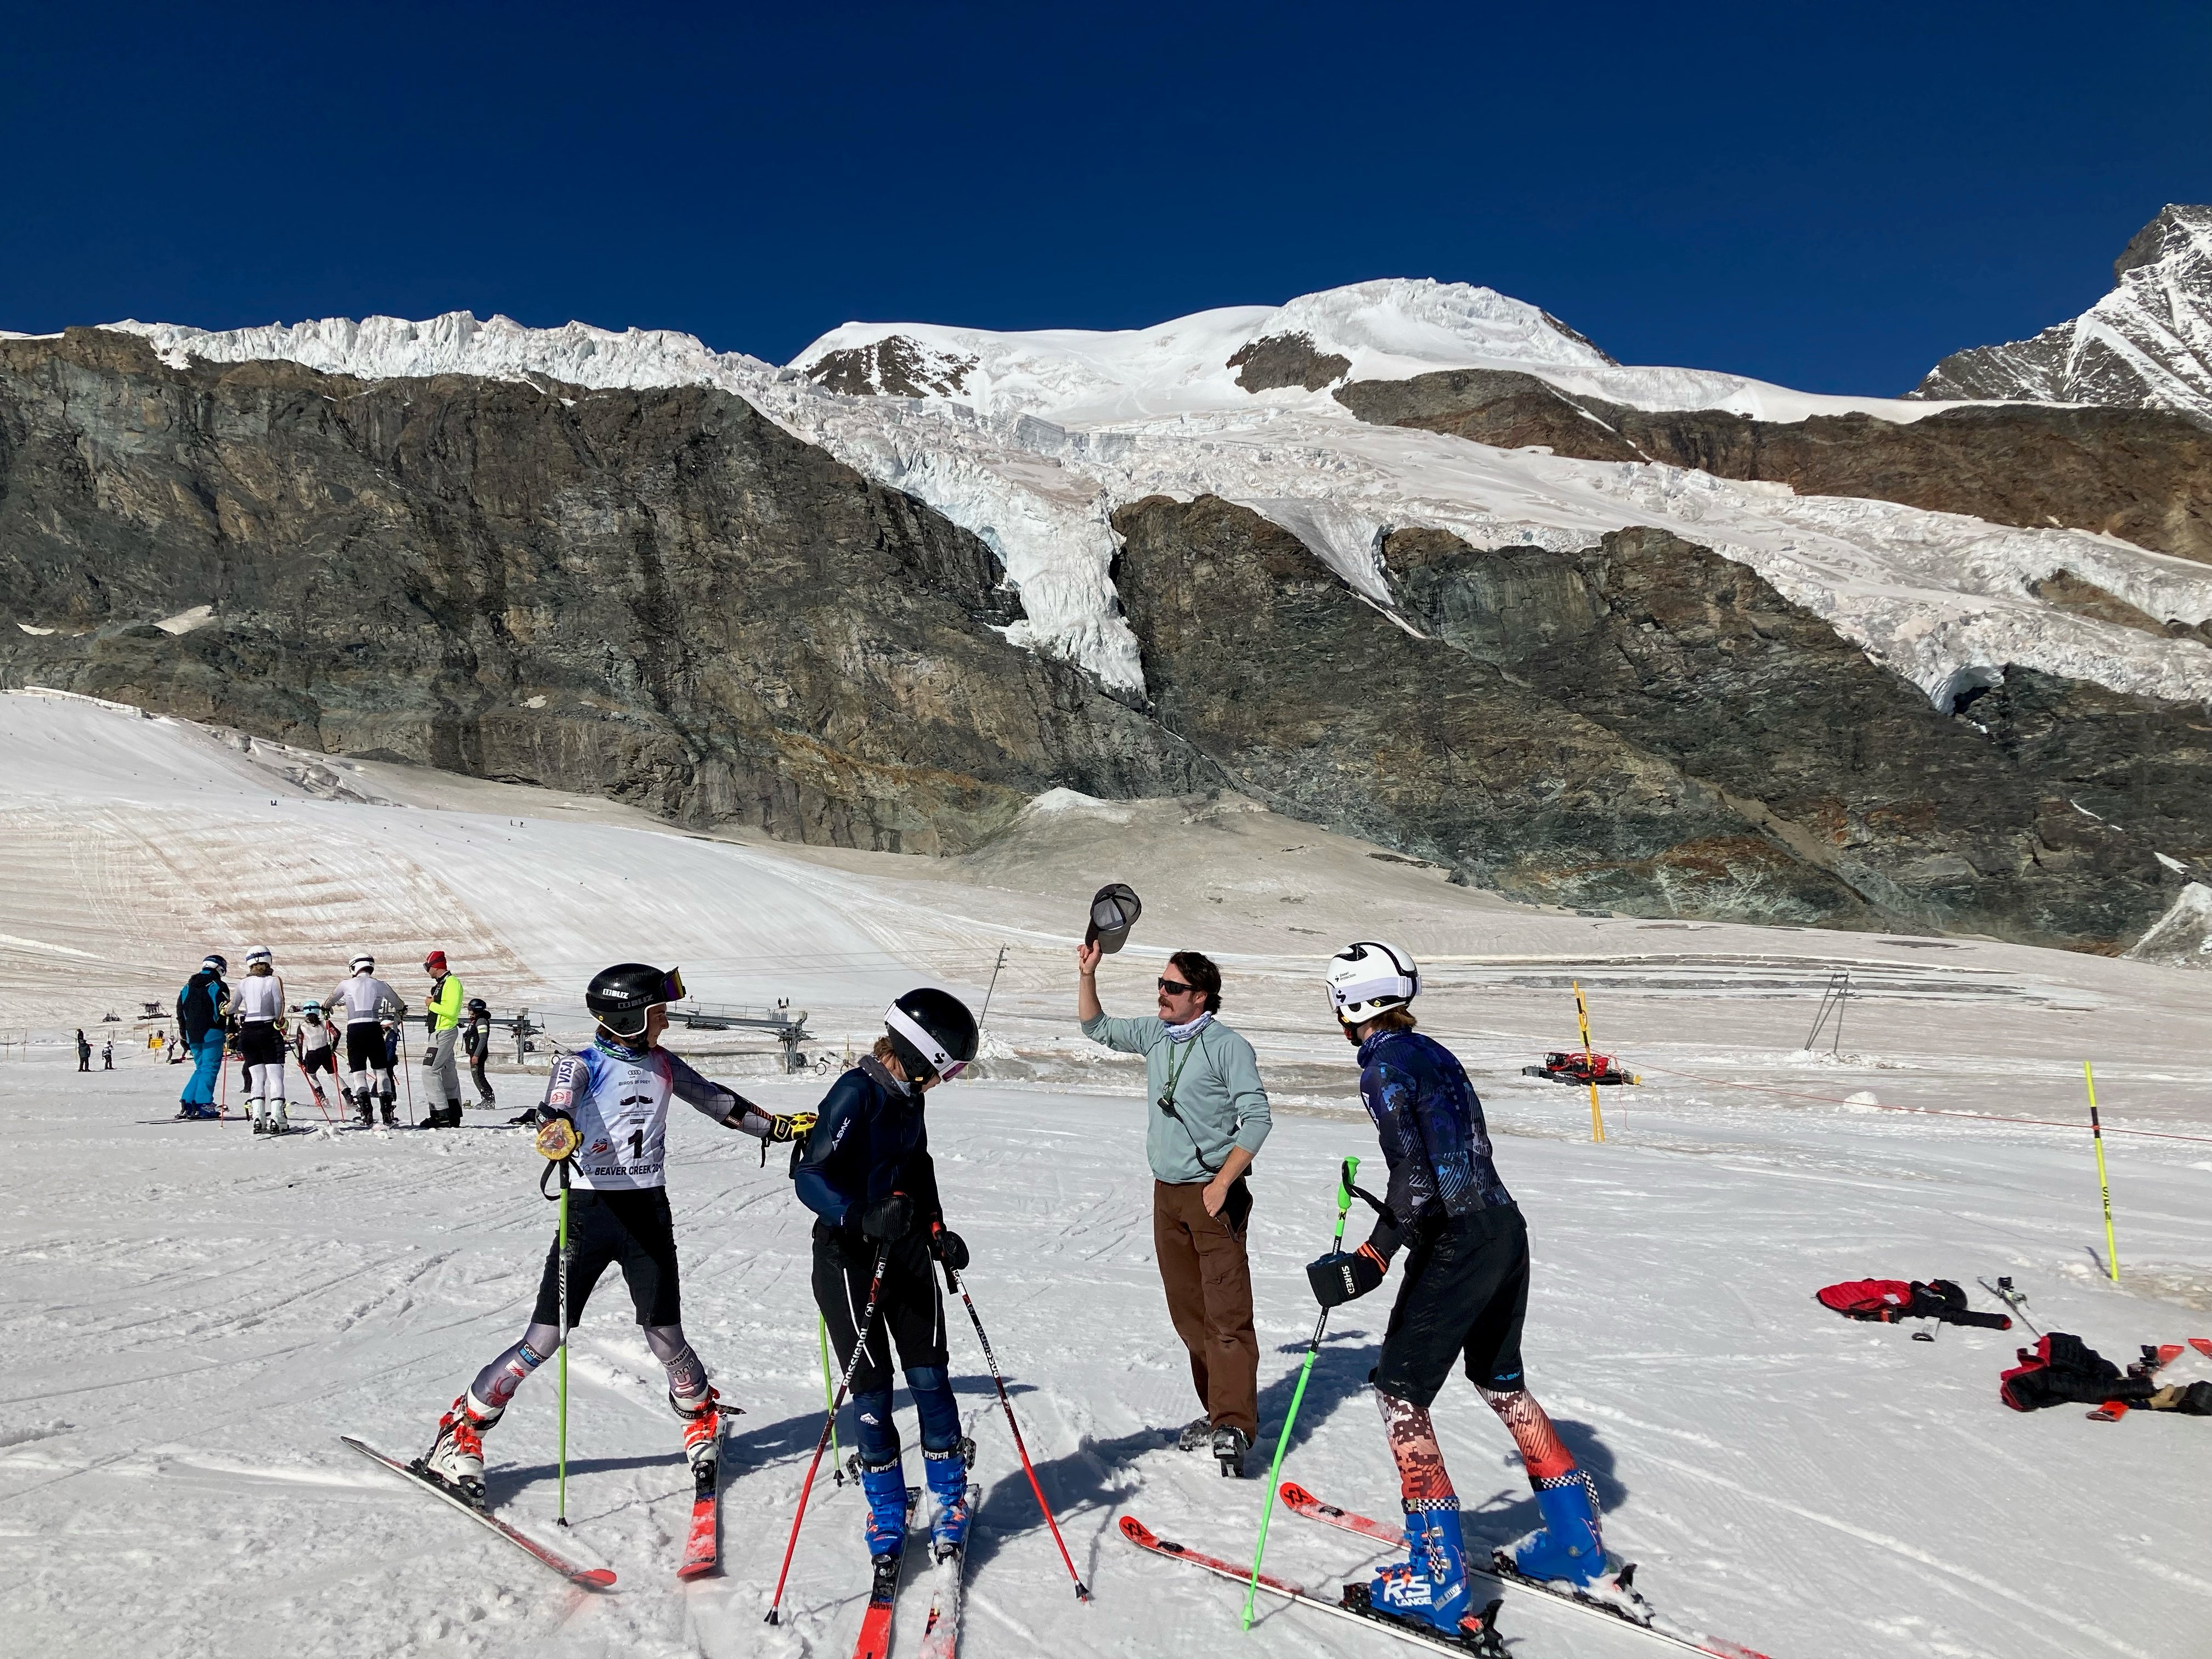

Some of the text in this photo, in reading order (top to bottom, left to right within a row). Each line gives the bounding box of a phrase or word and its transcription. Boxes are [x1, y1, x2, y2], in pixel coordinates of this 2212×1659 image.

[557, 1062, 574, 1086] VISA
[628, 1129, 644, 1159] 1
[595, 1166, 627, 1176] BEAVER
[629, 1164, 652, 1175] CREEK
[1341, 1265, 1355, 1295] SHRED
[663, 1347, 689, 1366] utnam
[842, 1328, 868, 1387] ROSSIGNOL
[1384, 1575, 1431, 1602] RS
[1395, 1596, 1432, 1607] LANGE
